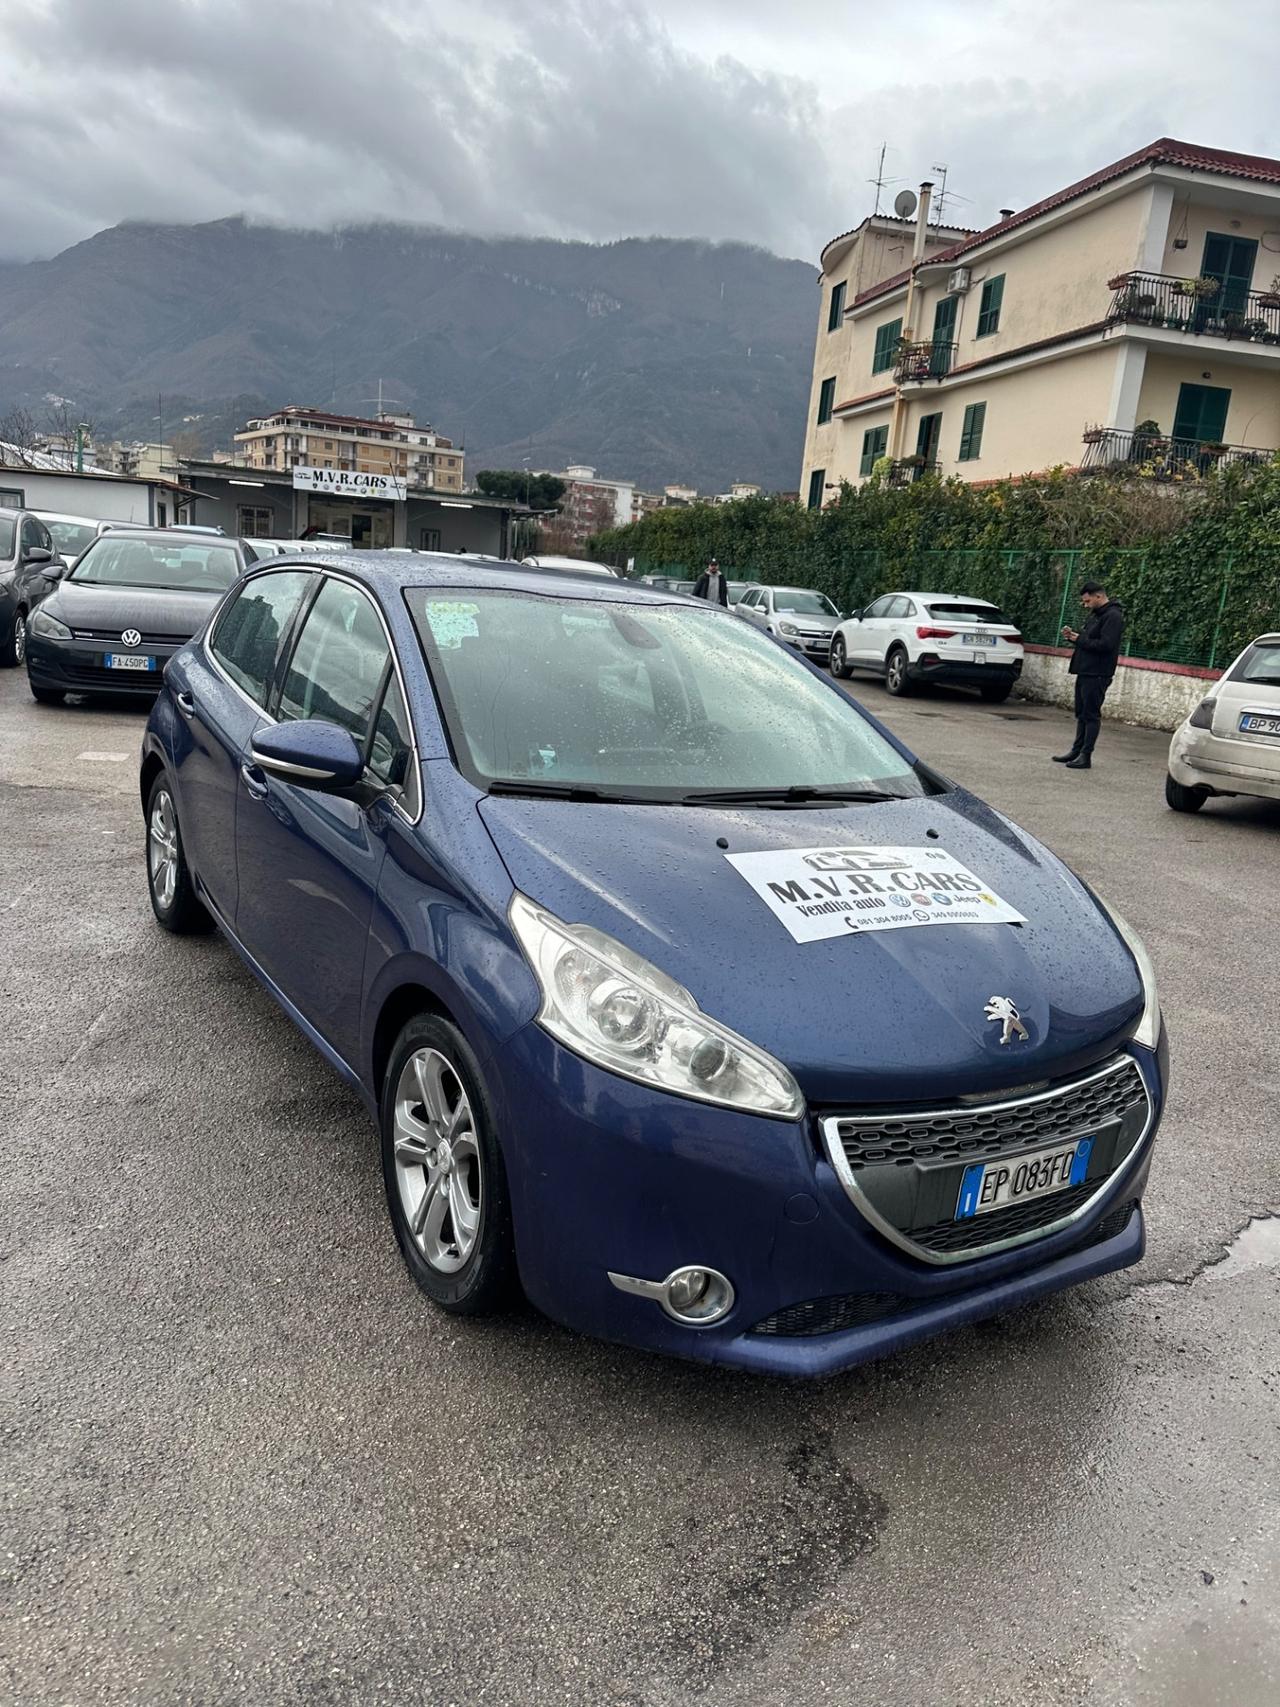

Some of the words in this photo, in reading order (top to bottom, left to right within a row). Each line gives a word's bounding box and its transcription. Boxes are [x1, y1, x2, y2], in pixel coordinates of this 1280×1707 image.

[313, 470, 387, 488] M.V.R.CARS
[1249, 718, 1267, 730] BP
[766, 871, 982, 904] M.V.R.CARS
[795, 900, 854, 917] Vendita
[852, 896, 886, 910] auto
[980, 1168, 1009, 1204] EP
